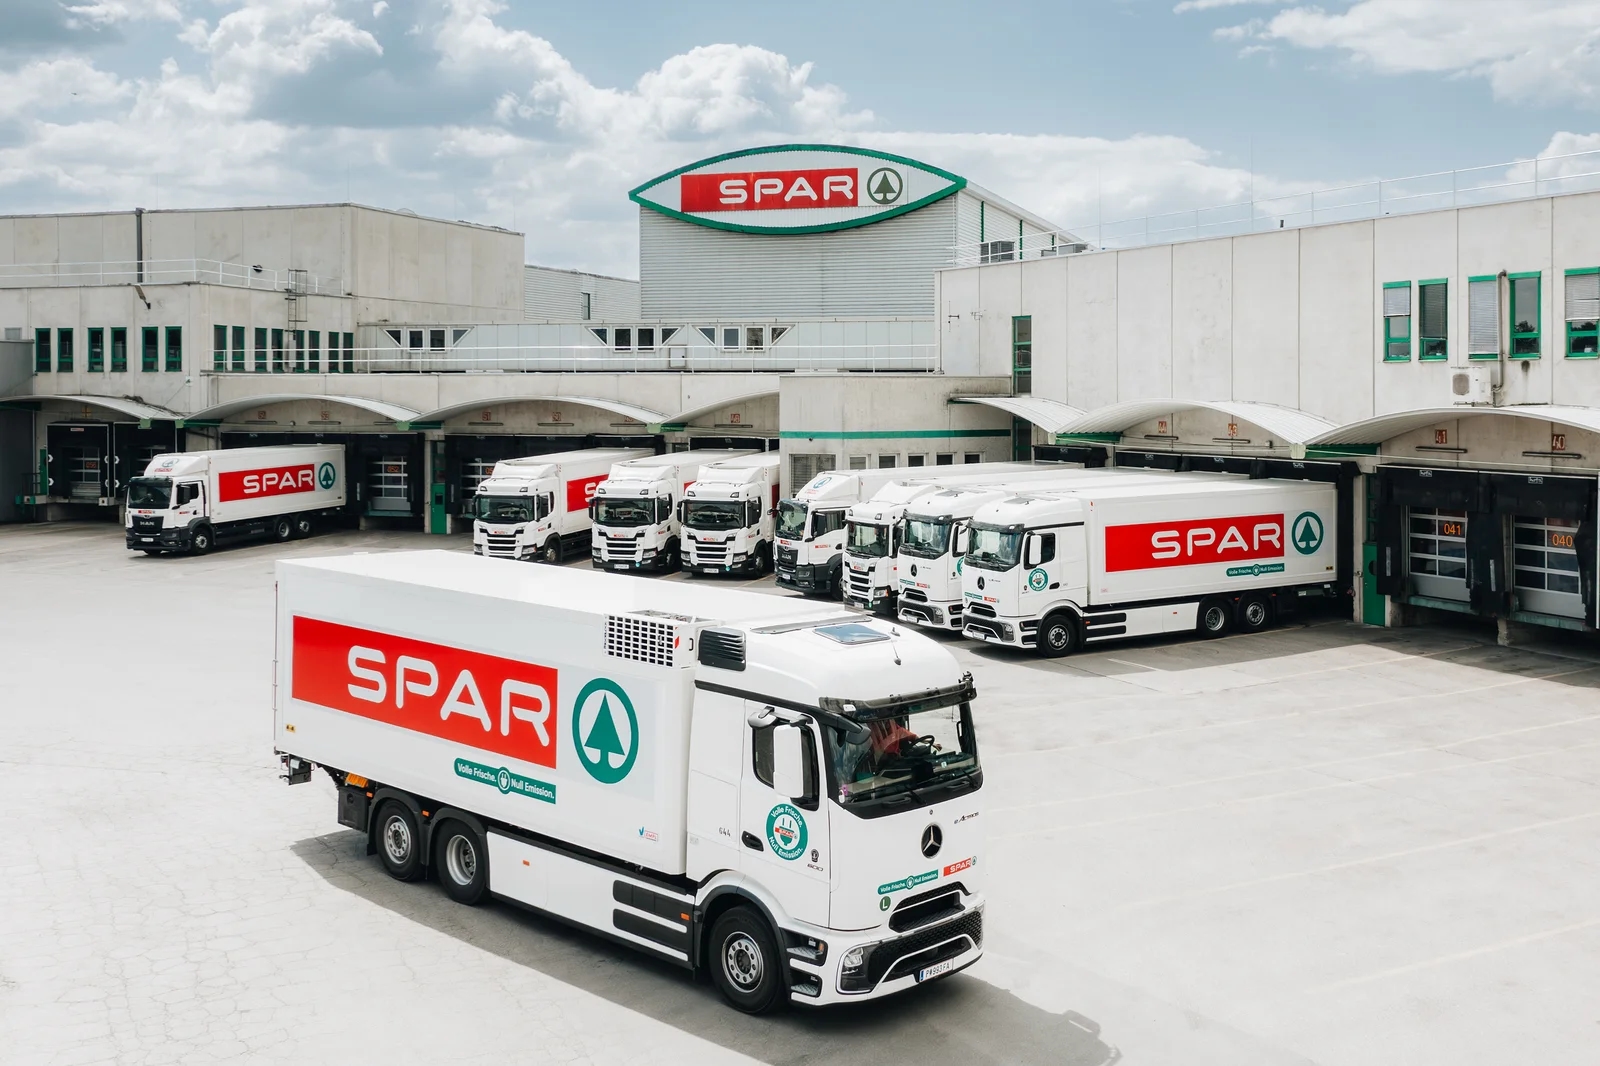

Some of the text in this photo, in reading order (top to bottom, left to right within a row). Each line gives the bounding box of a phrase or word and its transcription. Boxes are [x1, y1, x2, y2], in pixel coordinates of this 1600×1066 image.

[719, 175, 854, 204] SPAR
[1435, 430, 1447, 444] 41
[1552, 434, 1565, 450] 40
[243, 469, 314, 494] SPAR
[1443, 523, 1461, 536] 041
[1151, 522, 1281, 559] SPAR
[1552, 534, 1573, 547] 040
[347, 645, 550, 747] SPAR
[457, 763, 555, 799] Volle Frische. Null Emission.
[771, 806, 803, 828] Volle Frische.
[719, 827, 731, 837] 644
[769, 836, 780, 851] Null
[950, 859, 971, 873] SPAR
[880, 885, 891, 893] Volle
[882, 899, 888, 908] L
